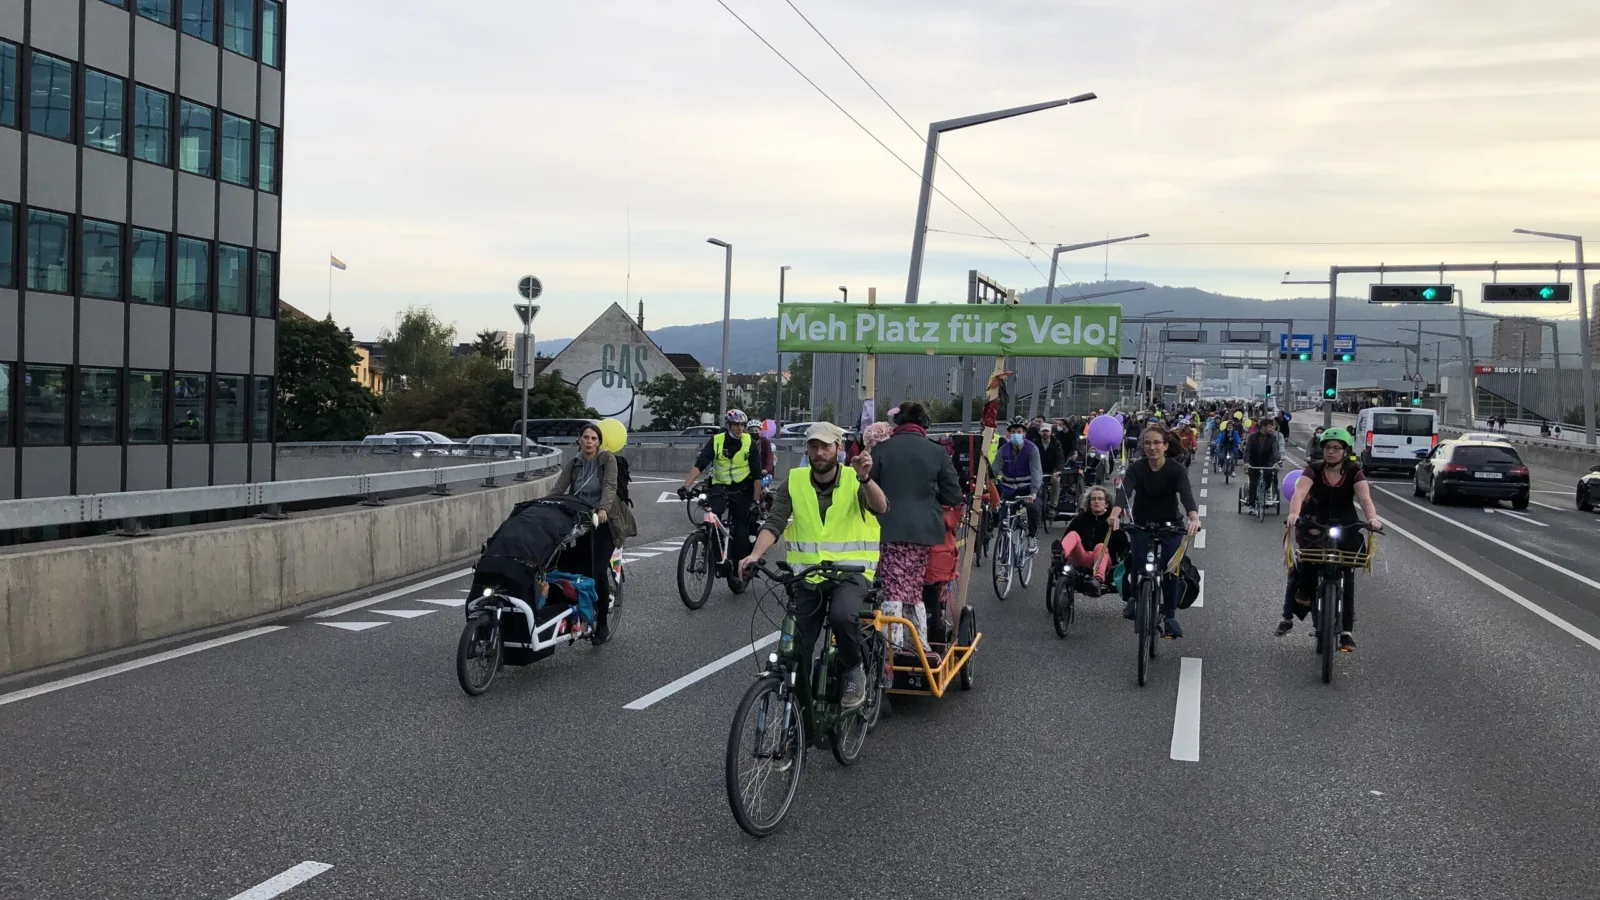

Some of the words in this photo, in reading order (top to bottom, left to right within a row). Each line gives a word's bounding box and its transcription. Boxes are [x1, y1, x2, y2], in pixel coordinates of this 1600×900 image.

[779, 313, 847, 341] Meh
[856, 313, 940, 343] Platz
[947, 313, 1018, 344] fürs
[1026, 314, 1117, 345] Velo!
[601, 343, 649, 389] GAS
